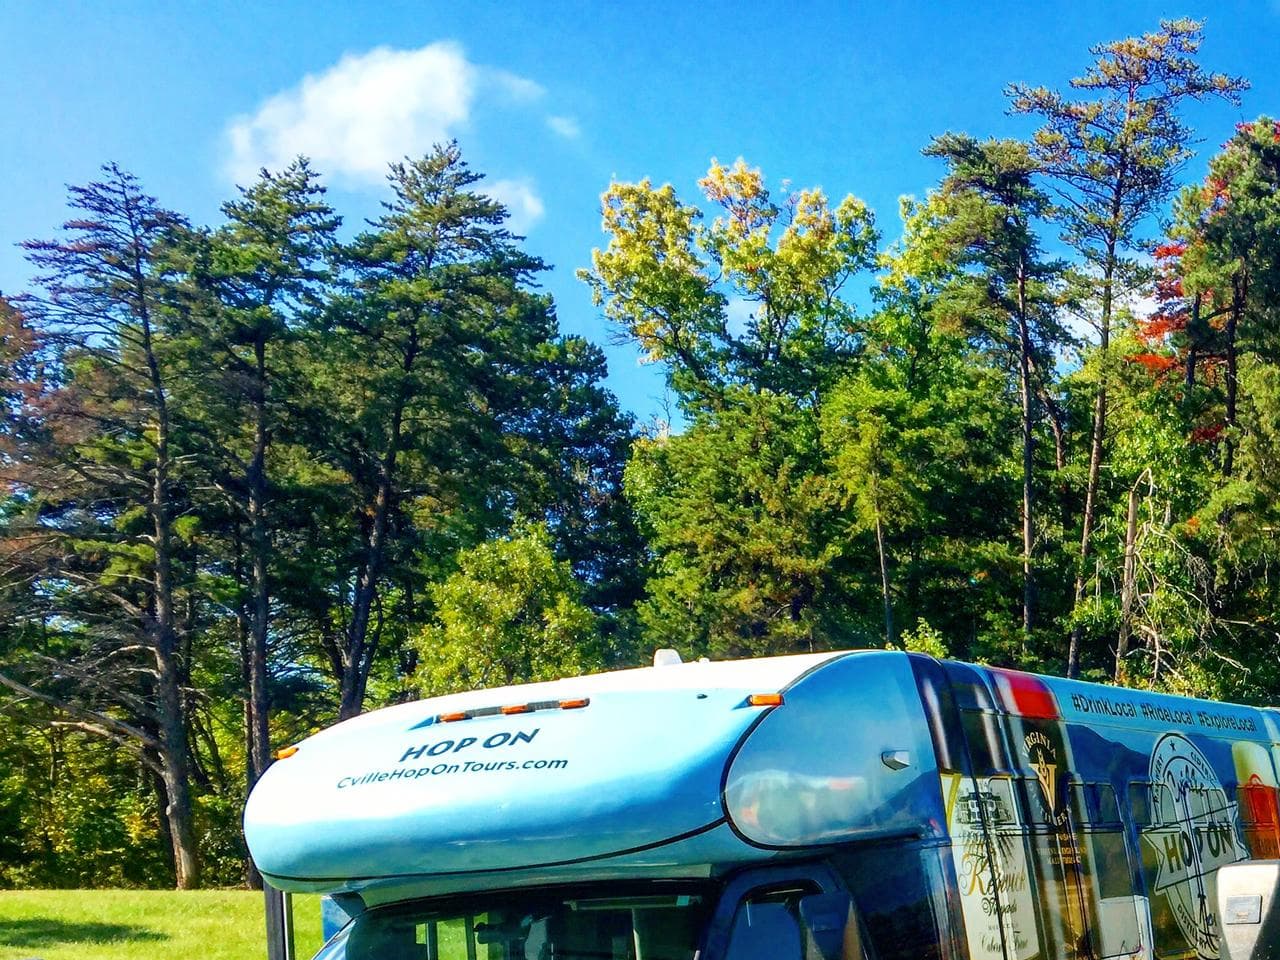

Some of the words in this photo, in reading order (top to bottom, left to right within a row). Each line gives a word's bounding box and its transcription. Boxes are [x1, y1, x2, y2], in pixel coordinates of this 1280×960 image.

[1071, 693, 1137, 718] #DrinkLocal
[1141, 703, 1195, 725] #RideLocal
[1198, 711, 1257, 732] #ExploreLocal
[399, 737, 477, 762] HOP
[483, 728, 541, 748] ON
[336, 759, 569, 789] CvilleHopOnTours.com
[1207, 822, 1234, 857] ON
